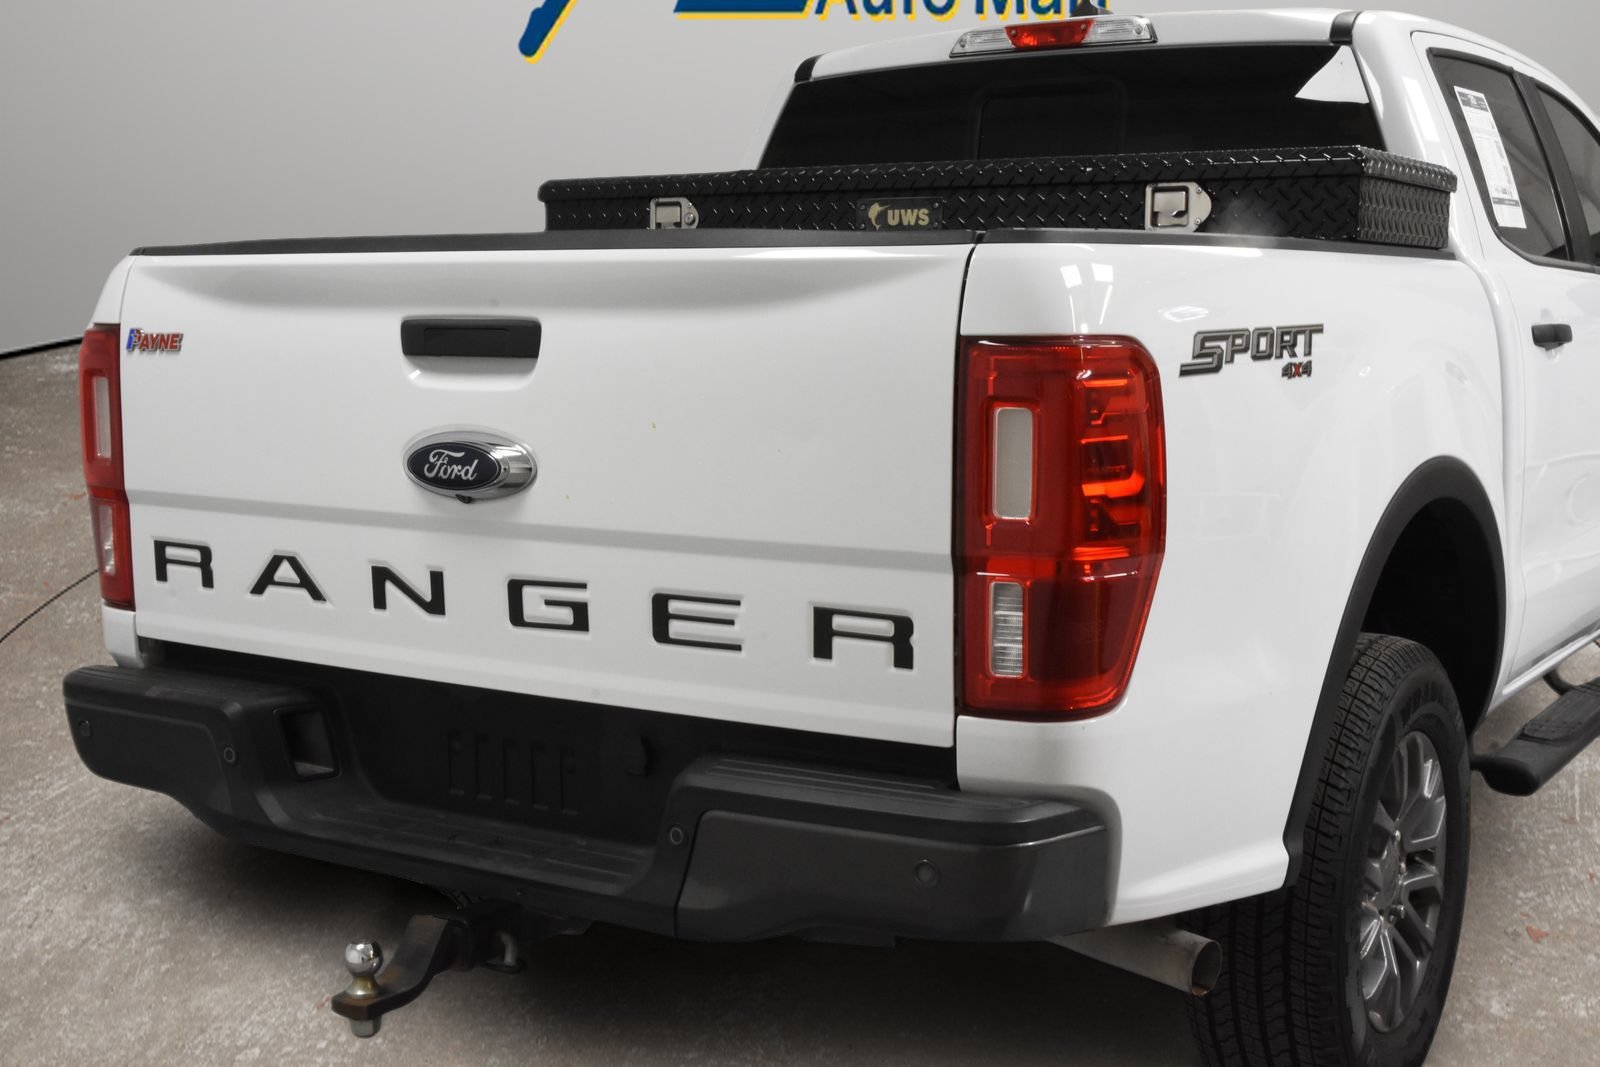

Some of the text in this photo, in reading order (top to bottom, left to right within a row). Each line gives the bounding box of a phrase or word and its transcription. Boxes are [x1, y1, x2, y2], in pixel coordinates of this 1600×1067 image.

[887, 208, 929, 226] UWS
[126, 328, 184, 352] PAYNE
[1178, 323, 1324, 378] SPORT
[423, 448, 479, 481] Ford
[152, 538, 915, 671] RANGER
